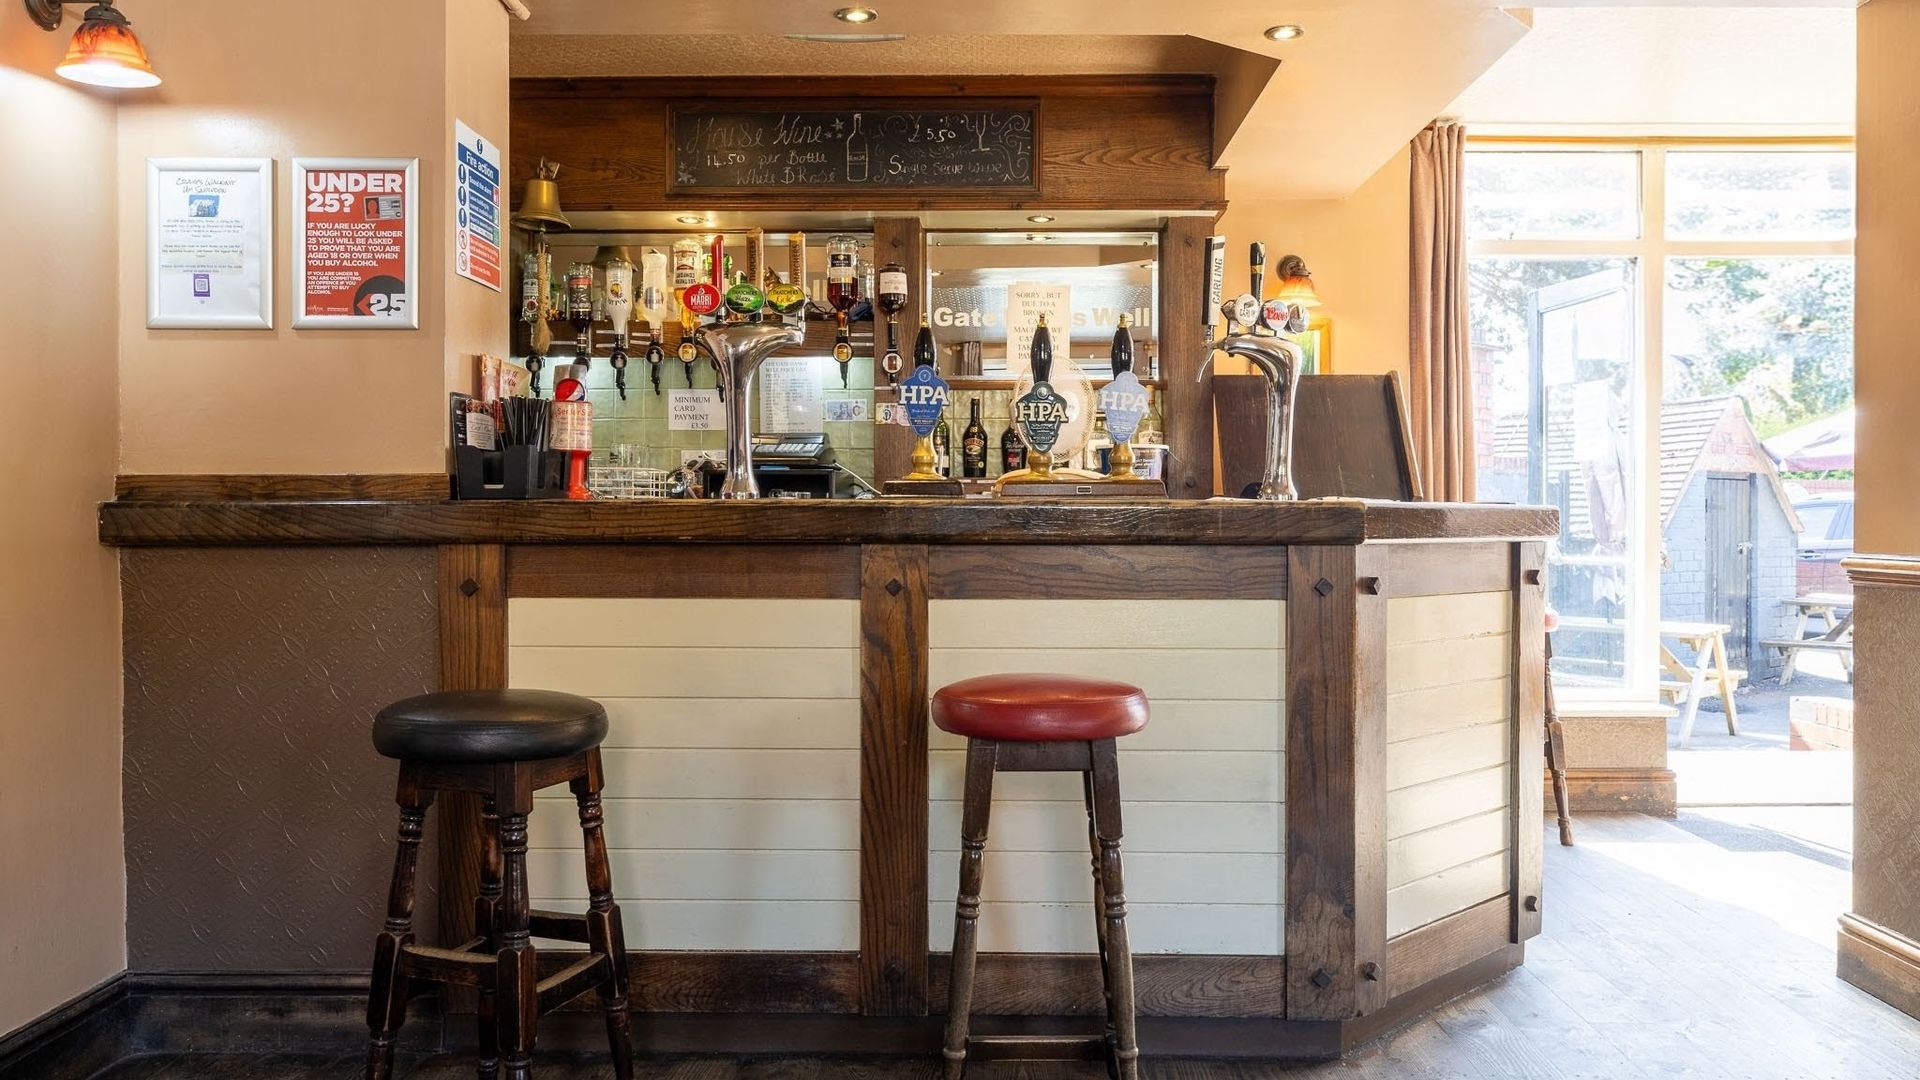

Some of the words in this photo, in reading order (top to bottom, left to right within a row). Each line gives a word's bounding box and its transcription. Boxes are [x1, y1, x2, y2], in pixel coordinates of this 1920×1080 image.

[773, 115, 823, 145] Wine
[466, 151, 476, 167] Fire
[477, 161, 493, 179] action
[706, 153, 746, 168] 14.50
[760, 154, 781, 169] per
[788, 150, 828, 165] Bottle
[888, 154, 927, 177] Single
[307, 172, 403, 193] UNDER
[736, 166, 776, 184] White
[307, 193, 354, 213] 25?
[1212, 258, 1223, 304] CARLING
[370, 293, 405, 315] 25
[934, 307, 998, 327] Gate
[898, 385, 950, 405] HPA
[1098, 391, 1150, 413] HPA
[1017, 402, 1069, 422] HPA
